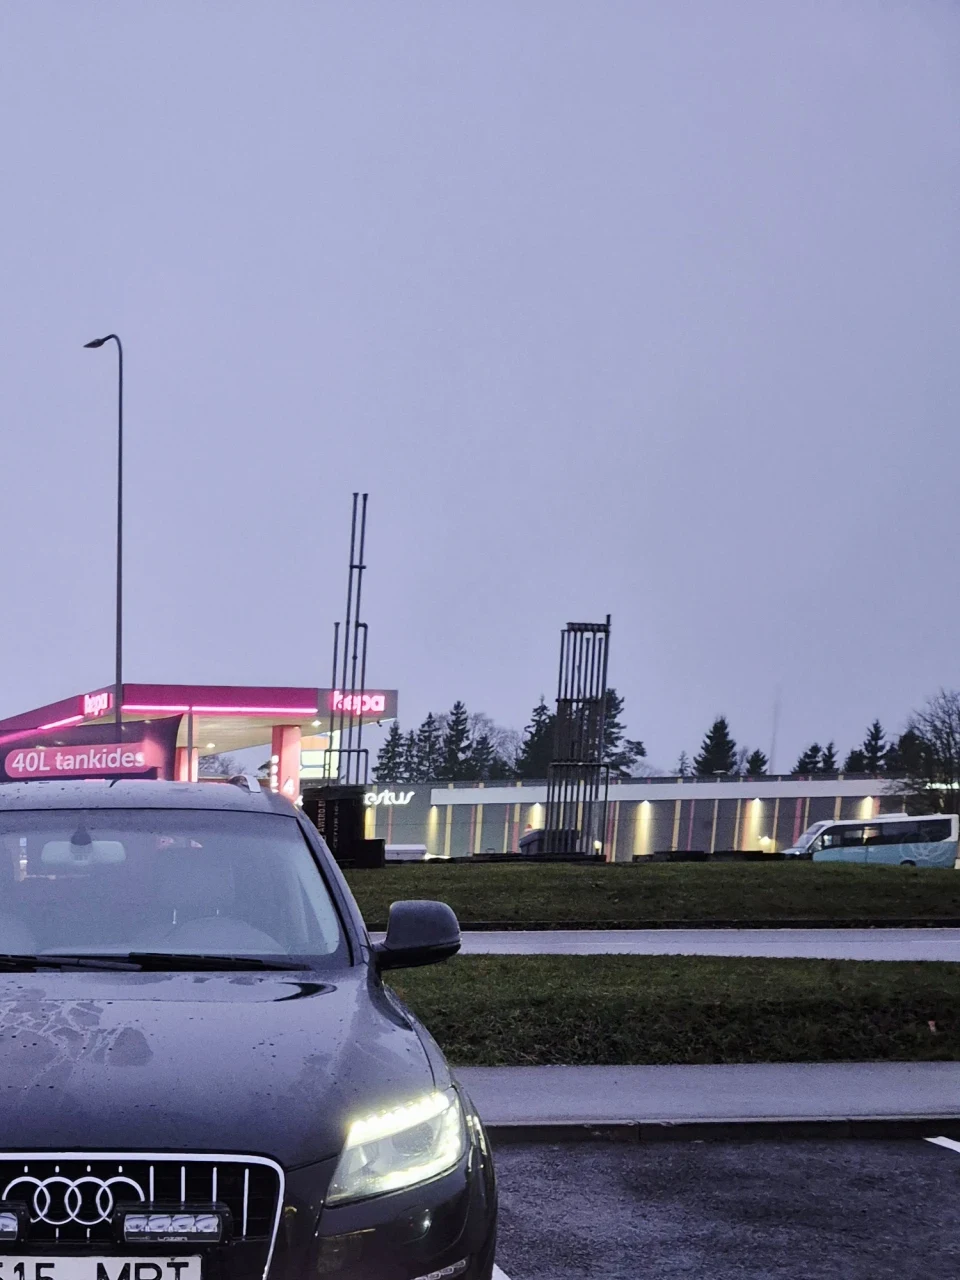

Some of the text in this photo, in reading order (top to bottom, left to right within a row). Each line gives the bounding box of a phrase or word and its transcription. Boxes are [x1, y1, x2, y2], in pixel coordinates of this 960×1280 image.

[333, 690, 385, 715] hepa
[12, 752, 50, 772] 40L
[55, 747, 146, 770] tankides
